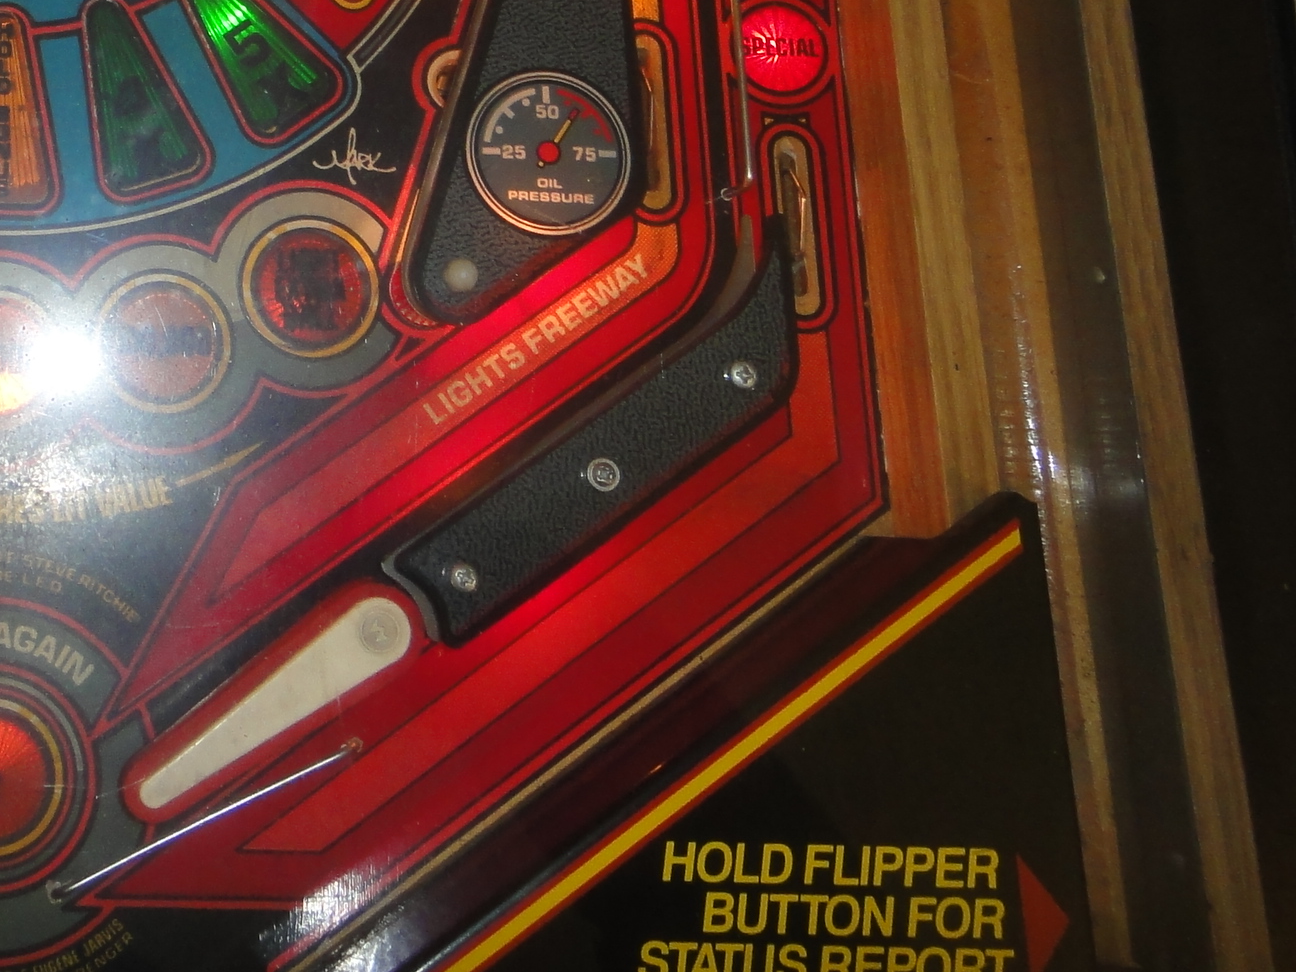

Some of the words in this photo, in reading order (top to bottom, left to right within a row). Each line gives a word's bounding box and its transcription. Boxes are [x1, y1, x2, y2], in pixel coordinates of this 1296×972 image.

[742, 37, 820, 58] SPECIAL
[535, 103, 560, 120] 50
[501, 144, 527, 160] 25
[572, 146, 597, 161] 75
[507, 189, 595, 206] PRESSURE
[536, 177, 563, 190] OIL
[422, 343, 526, 425] LIGHTS
[521, 253, 649, 355] FREEWAY
[52, 489, 89, 523] LIT
[95, 475, 174, 518] VALUE
[23, 554, 77, 581] STEVE
[77, 573, 141, 623] RITCHIE
[661, 840, 795, 885] HOLD
[803, 843, 1000, 890] FLIPPER
[702, 890, 896, 938] BUTTON
[906, 895, 1006, 940] FOR
[83, 918, 124, 958] JARVIS
[637, 940, 809, 972] STATUS
[820, 944, 1015, 972] REPORT
